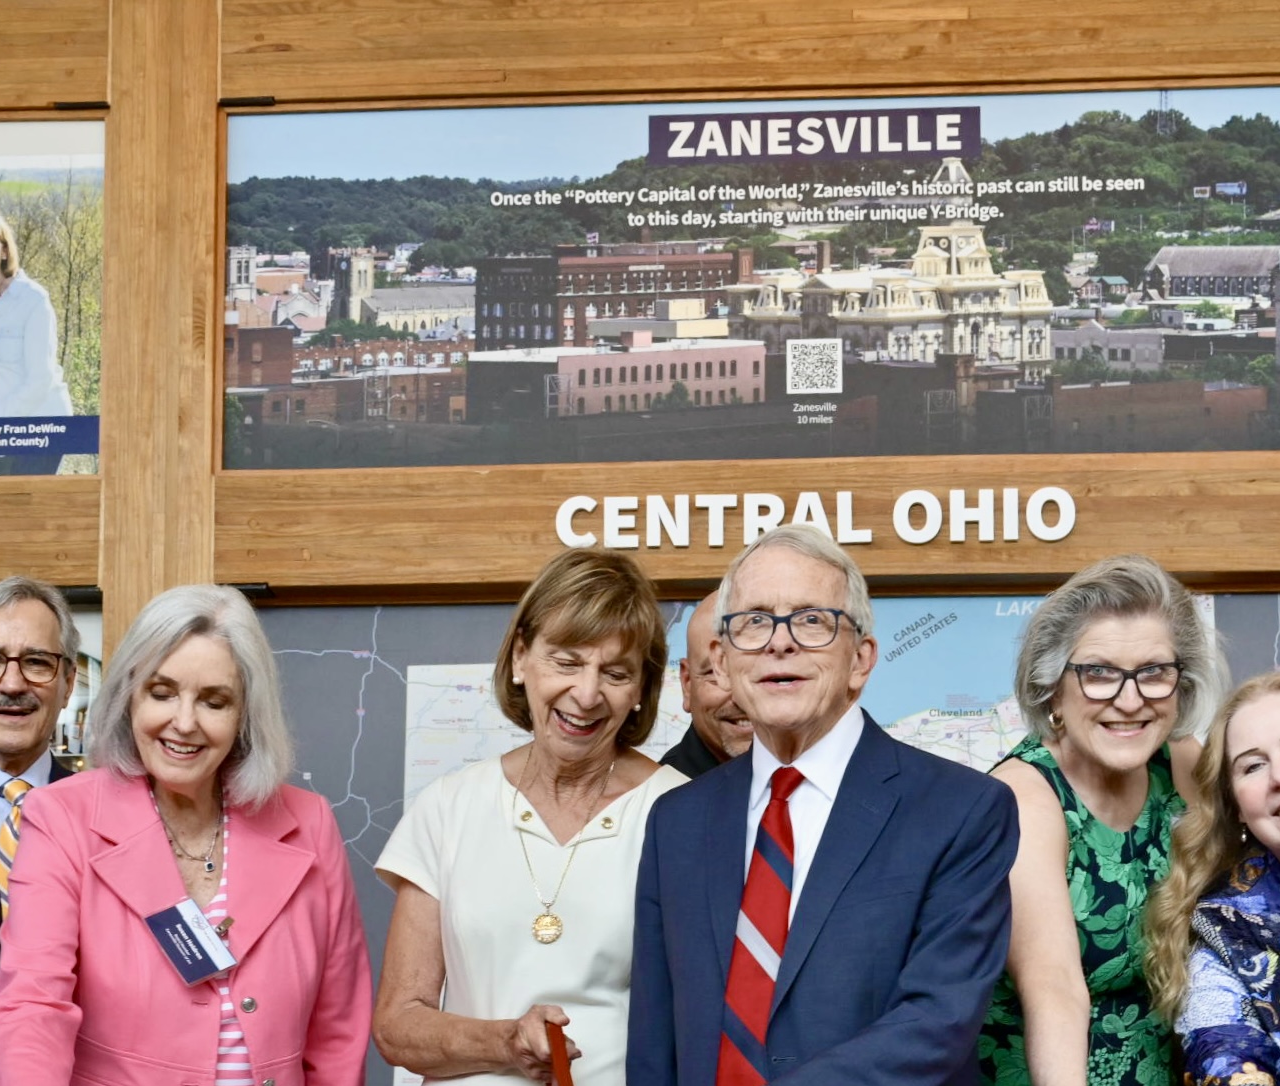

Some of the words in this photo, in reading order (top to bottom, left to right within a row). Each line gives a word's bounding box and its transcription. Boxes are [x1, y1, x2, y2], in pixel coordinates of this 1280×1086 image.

[667, 114, 962, 158] ZANESVILLE
[490, 191, 531, 206] Once
[534, 190, 562, 205] the
[564, 188, 634, 206] “Pottery
[637, 186, 695, 204] Capital
[698, 185, 716, 202] of
[717, 185, 745, 201] the
[748, 183, 810, 201] World,”
[813, 180, 909, 198] Zanesville’s
[913, 179, 973, 196] historic
[977, 179, 1012, 198] past
[1015, 180, 1045, 194] can
[1048, 177, 1078, 192] still
[1082, 176, 1103, 192] be
[1106, 178, 1145, 192] seen
[627, 211, 644, 227] to
[647, 210, 679, 226] this
[681, 210, 717, 228] day,
[719, 207, 784, 227] starting
[786, 206, 825, 223] with
[827, 204, 868, 222] their
[870, 204, 927, 224] unique
[930, 202, 1005, 223] Y-Bridge.
[792, 402, 837, 412] Zanesville
[4, 424, 27, 434] Fran
[28, 423, 67, 434] DeWine
[797, 415, 808, 424] 10
[809, 414, 833, 424] miles
[9, 436, 49, 448] County)
[554, 490, 873, 548] CENTRAL
[891, 486, 1077, 544] OHIO
[996, 600, 1042, 616] LAK
[885, 635, 922, 663] UNITED
[922, 612, 959, 640] STATES
[893, 612, 935, 643] CANADA
[929, 708, 983, 717] Cleveland
